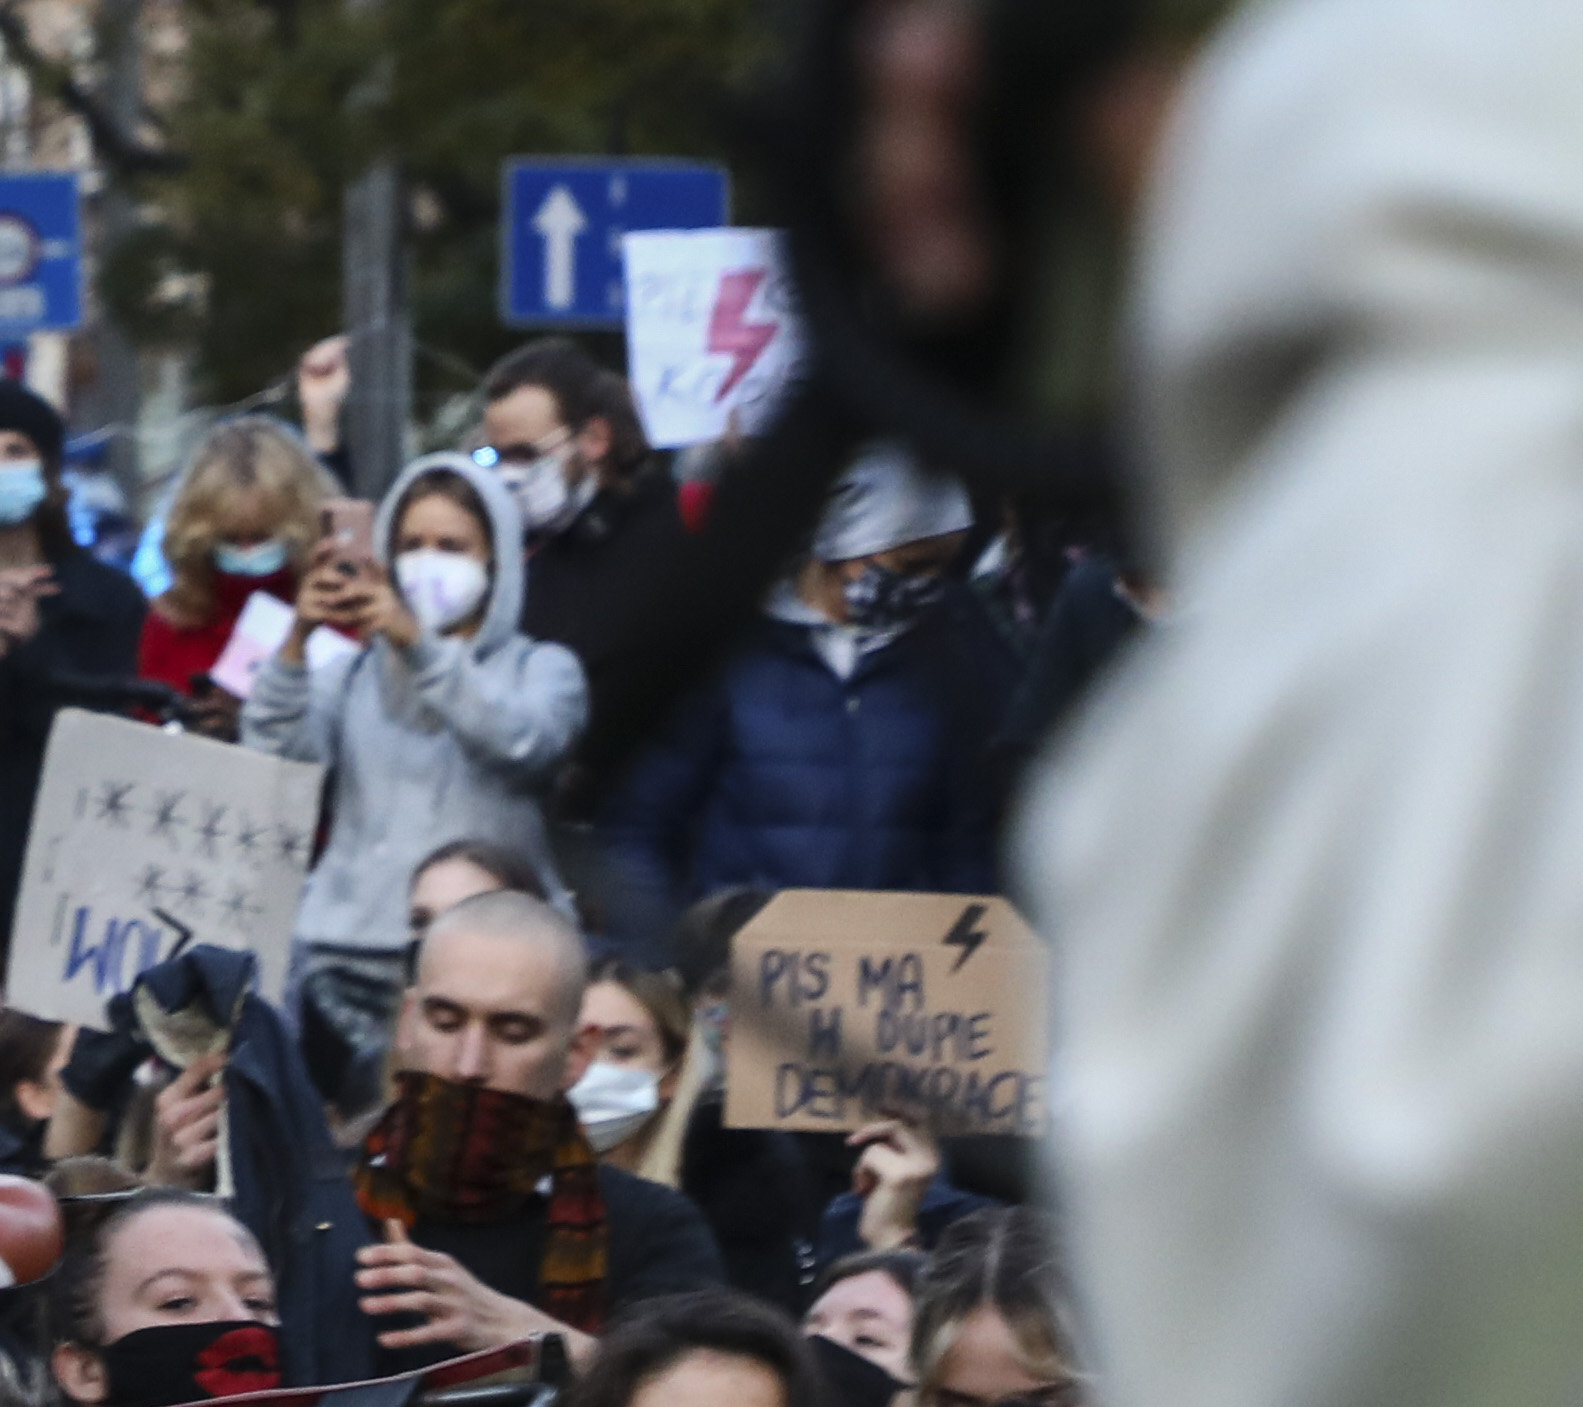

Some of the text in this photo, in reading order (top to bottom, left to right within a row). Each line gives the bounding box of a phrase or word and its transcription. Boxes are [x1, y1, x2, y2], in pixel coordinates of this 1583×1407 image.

[759, 947, 925, 1012] PIS MA
[876, 1008, 994, 1062] DUPIE
